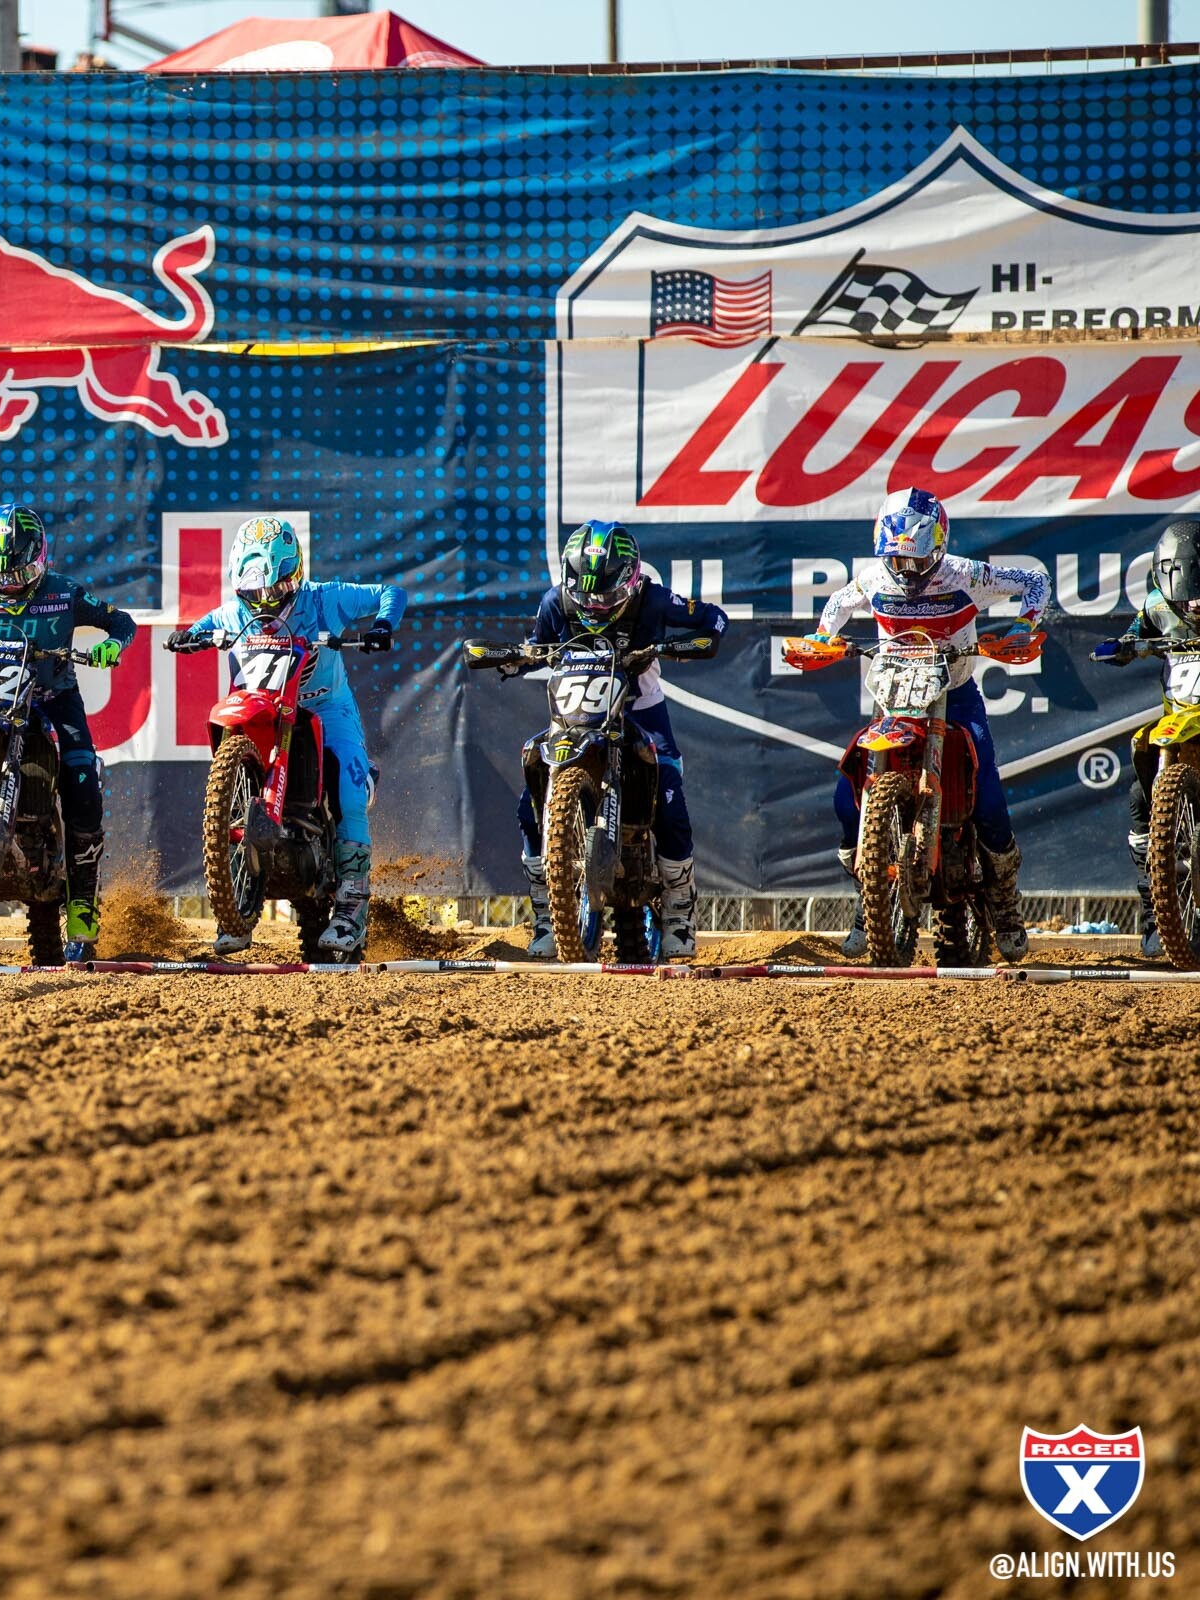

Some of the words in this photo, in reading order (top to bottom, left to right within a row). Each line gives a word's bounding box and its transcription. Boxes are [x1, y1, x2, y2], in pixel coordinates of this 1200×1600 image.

[992, 263, 1053, 292] HI-
[38, 603, 69, 613] YAMAHA
[5, 653, 16, 661] OIL
[1178, 655, 1200, 664] LUCA
[233, 652, 296, 690] 41
[555, 676, 621, 715] 59
[2, 771, 16, 824] DUNLOP
[273, 766, 286, 817] DUNLOP
[607, 788, 619, 842] DUNLOP
[156, 962, 206, 970] Hangtown
[445, 962, 495, 970] Hangtown
[1073, 970, 1128, 978] Hangtown
